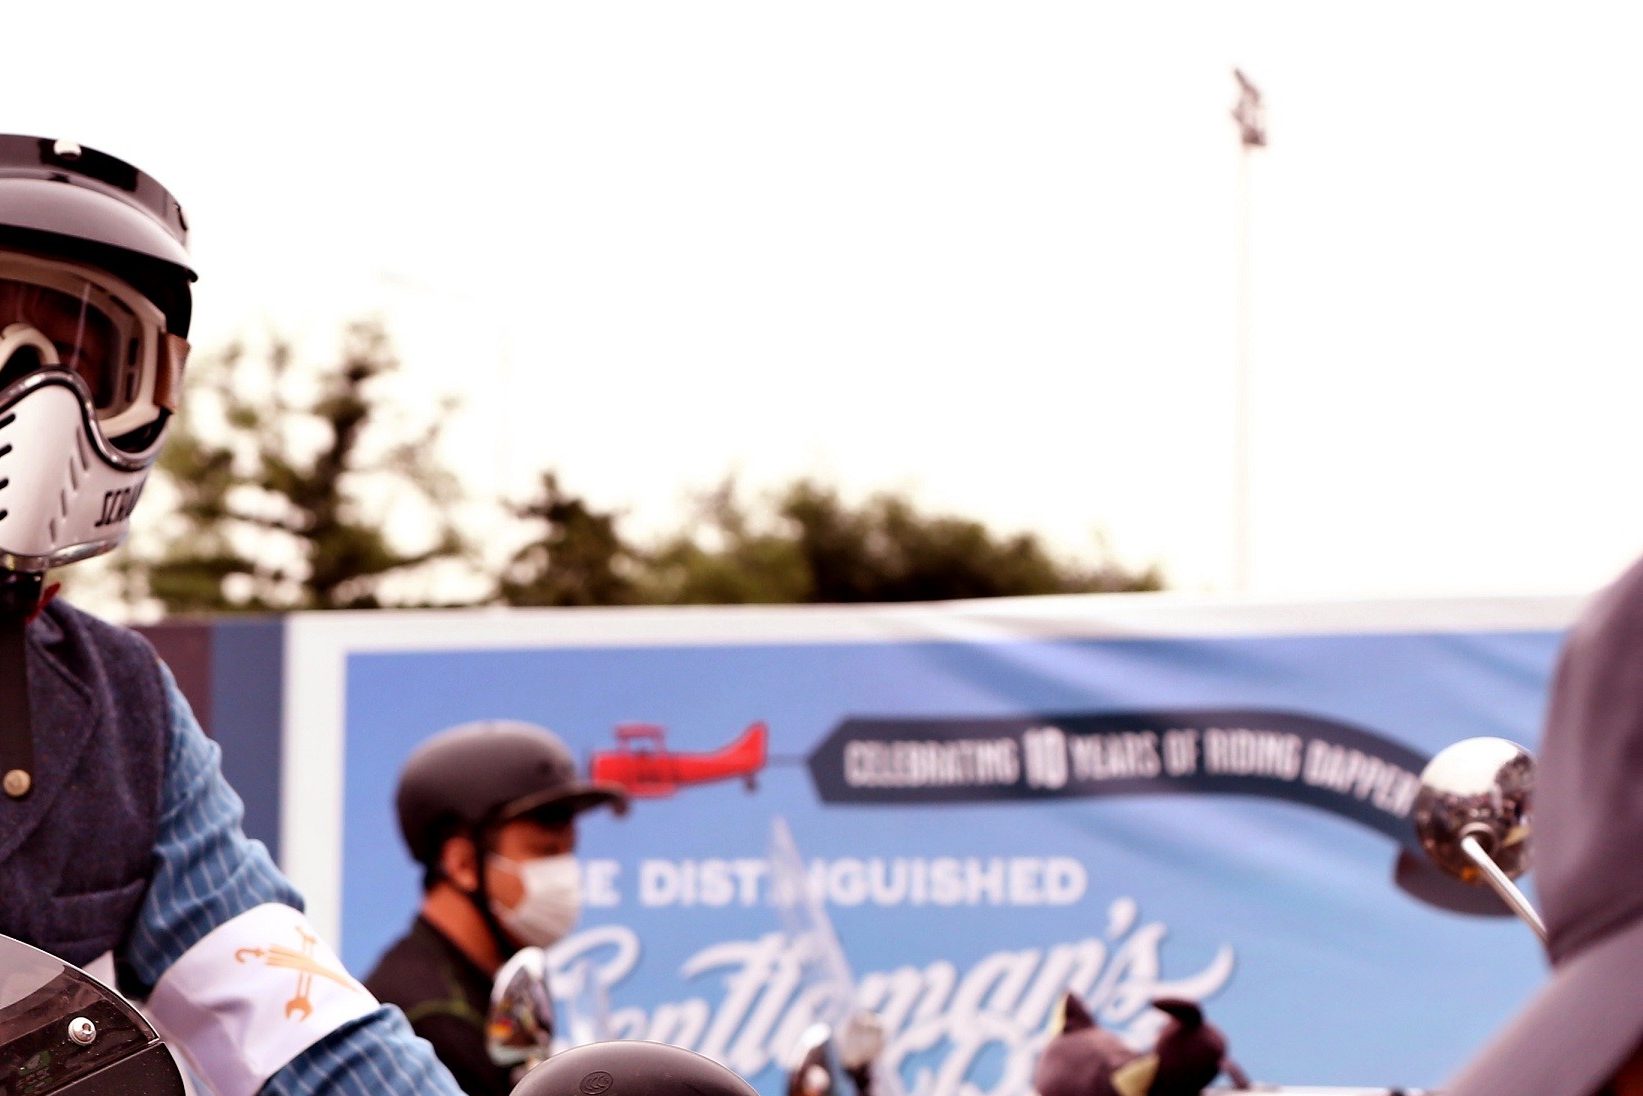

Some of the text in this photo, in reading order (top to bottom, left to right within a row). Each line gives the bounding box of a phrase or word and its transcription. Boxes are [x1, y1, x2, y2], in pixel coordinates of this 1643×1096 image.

[844, 739, 1019, 788] CELEBRATING
[1022, 726, 1068, 789] 10
[1069, 731, 1161, 781] YEARS
[1162, 728, 1198, 777] OF
[1203, 727, 1302, 781] RIDING
